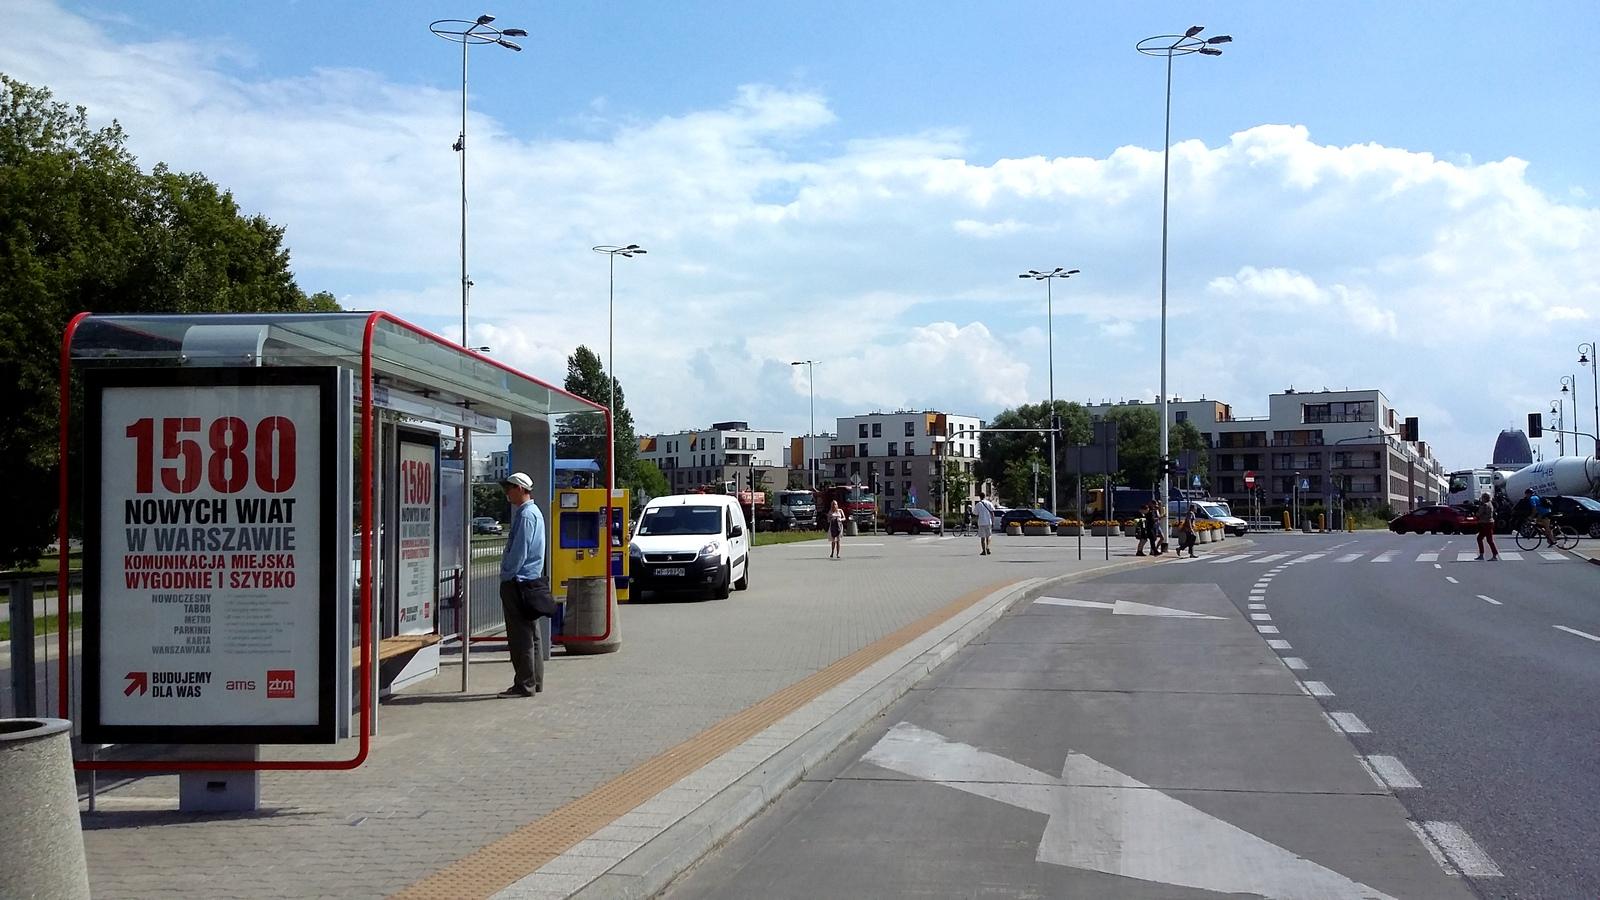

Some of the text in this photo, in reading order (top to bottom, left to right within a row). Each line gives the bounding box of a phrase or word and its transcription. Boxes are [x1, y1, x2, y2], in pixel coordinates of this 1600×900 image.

[126, 416, 296, 494] 1580
[402, 460, 431, 505] 1580
[125, 498, 296, 525] NOWYCH WIAT
[126, 527, 296, 552] W WARSZAWIE
[124, 554, 295, 570] KOMUNIKACJA MIEJSKA
[125, 571, 295, 589] WYGODNIE I SZYBKO
[152, 594, 211, 603] NOWOCZESNY
[184, 604, 211, 613] TABOR
[184, 616, 211, 624] METRO
[174, 626, 211, 635] PARKINGI
[186, 636, 211, 645] KARTA
[152, 646, 211, 655] WARSZAWIAKA
[152, 672, 212, 684] BUDUJEMY
[269, 678, 293, 690] ztm
[226, 680, 256, 690] ams
[152, 686, 201, 698] DLA WAS
